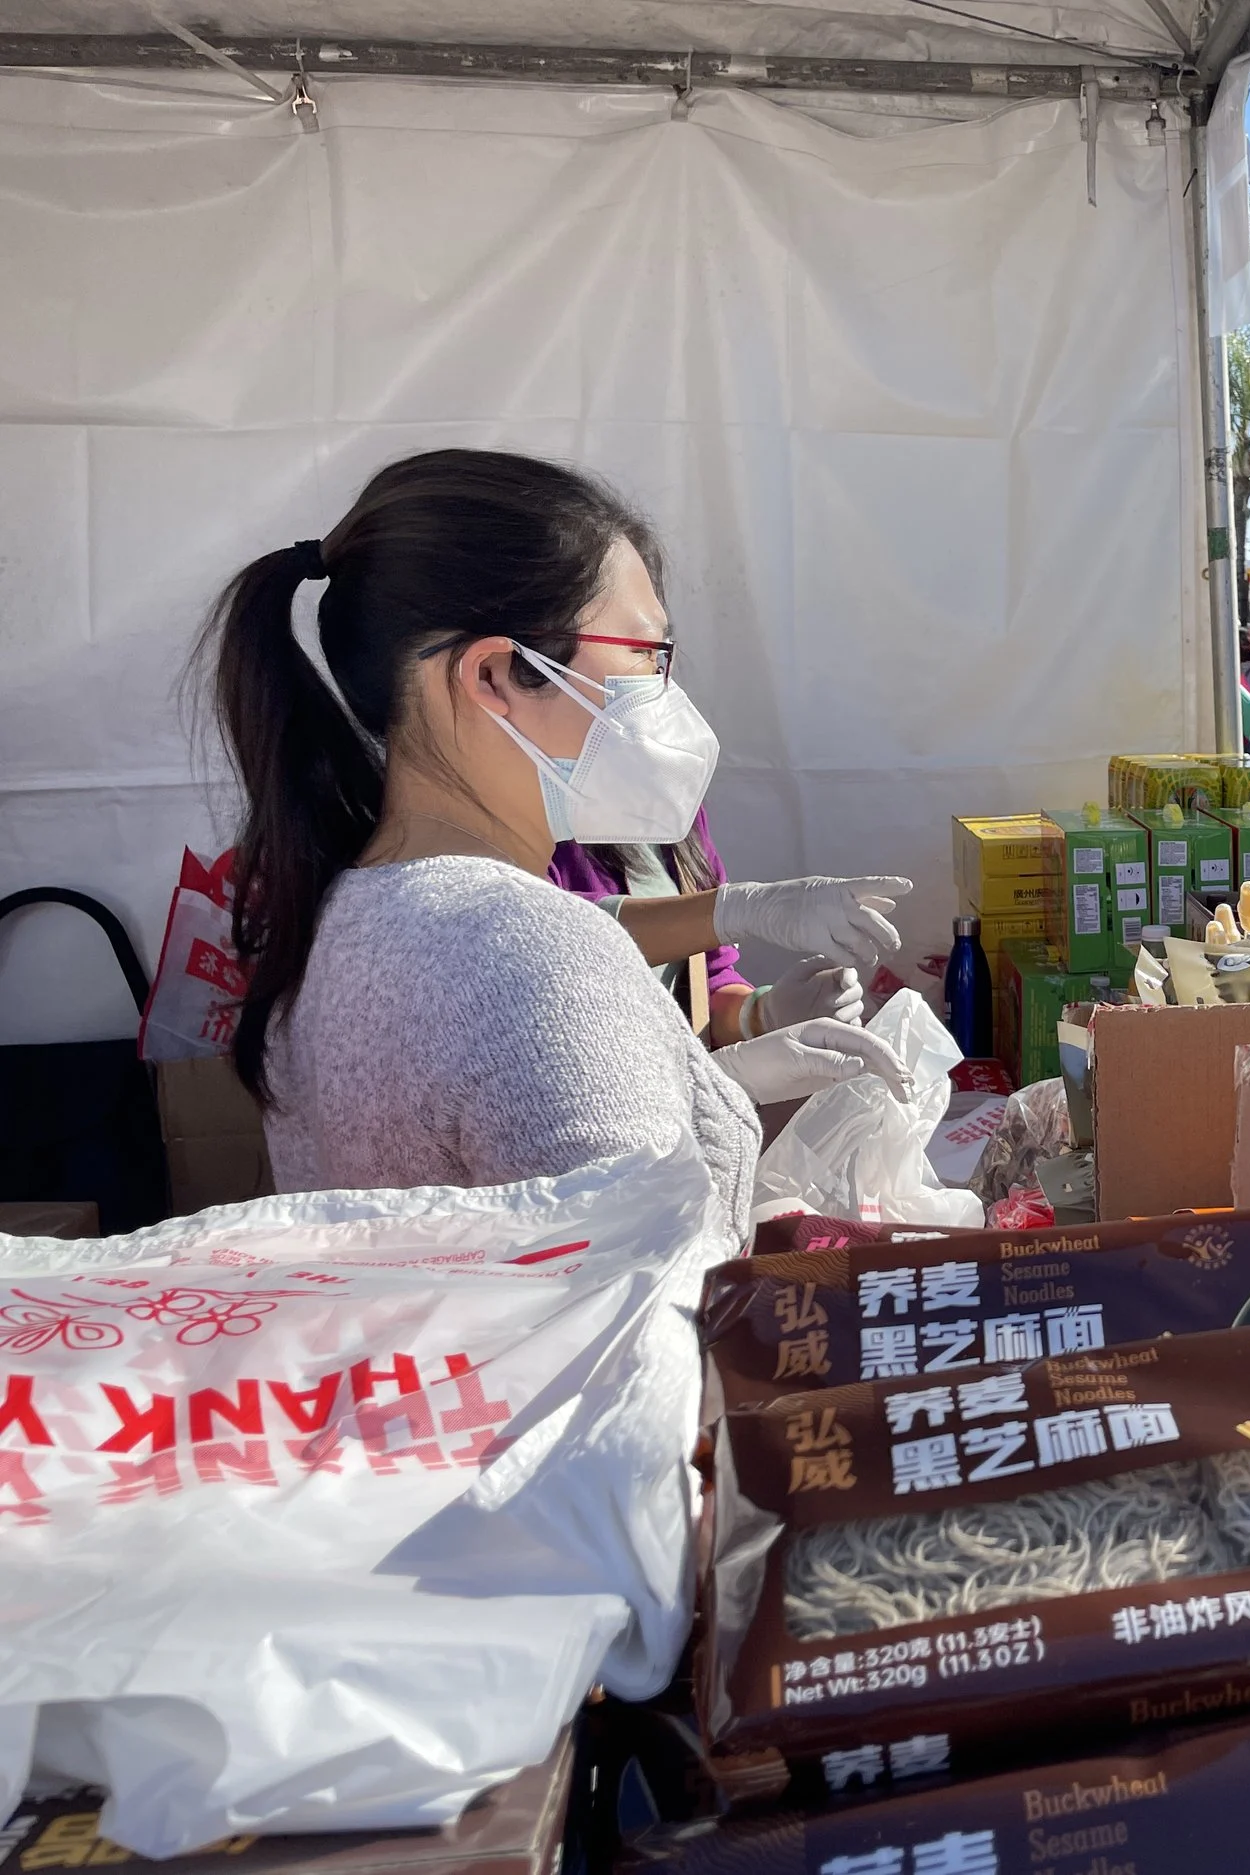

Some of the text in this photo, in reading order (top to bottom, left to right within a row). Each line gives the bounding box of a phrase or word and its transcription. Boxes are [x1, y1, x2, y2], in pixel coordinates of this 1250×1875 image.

[1000, 1233, 1101, 1258] Buckwheat
[858, 1261, 981, 1318] 荞麦
[1001, 1261, 1071, 1282] Sesame
[1004, 1283, 1075, 1307] Noodles
[772, 1282, 832, 1381] 弘威
[859, 1304, 1106, 1381] 黑芝麻面
[1046, 1347, 1159, 1374] Buckwheat
[1049, 1371, 1129, 1388] Sesame
[884, 1371, 1029, 1435] 荞麦
[1055, 1387, 1136, 1407] Noodles
[785, 1406, 857, 1494] 弘威
[890, 1402, 1181, 1495] 黑芝麻面
[784, 1682, 824, 1705] Net
[822, 1733, 951, 1791] 荞麦
[1022, 1770, 1168, 1823] Buckwheat
[1028, 1818, 1129, 1863] Sesame
